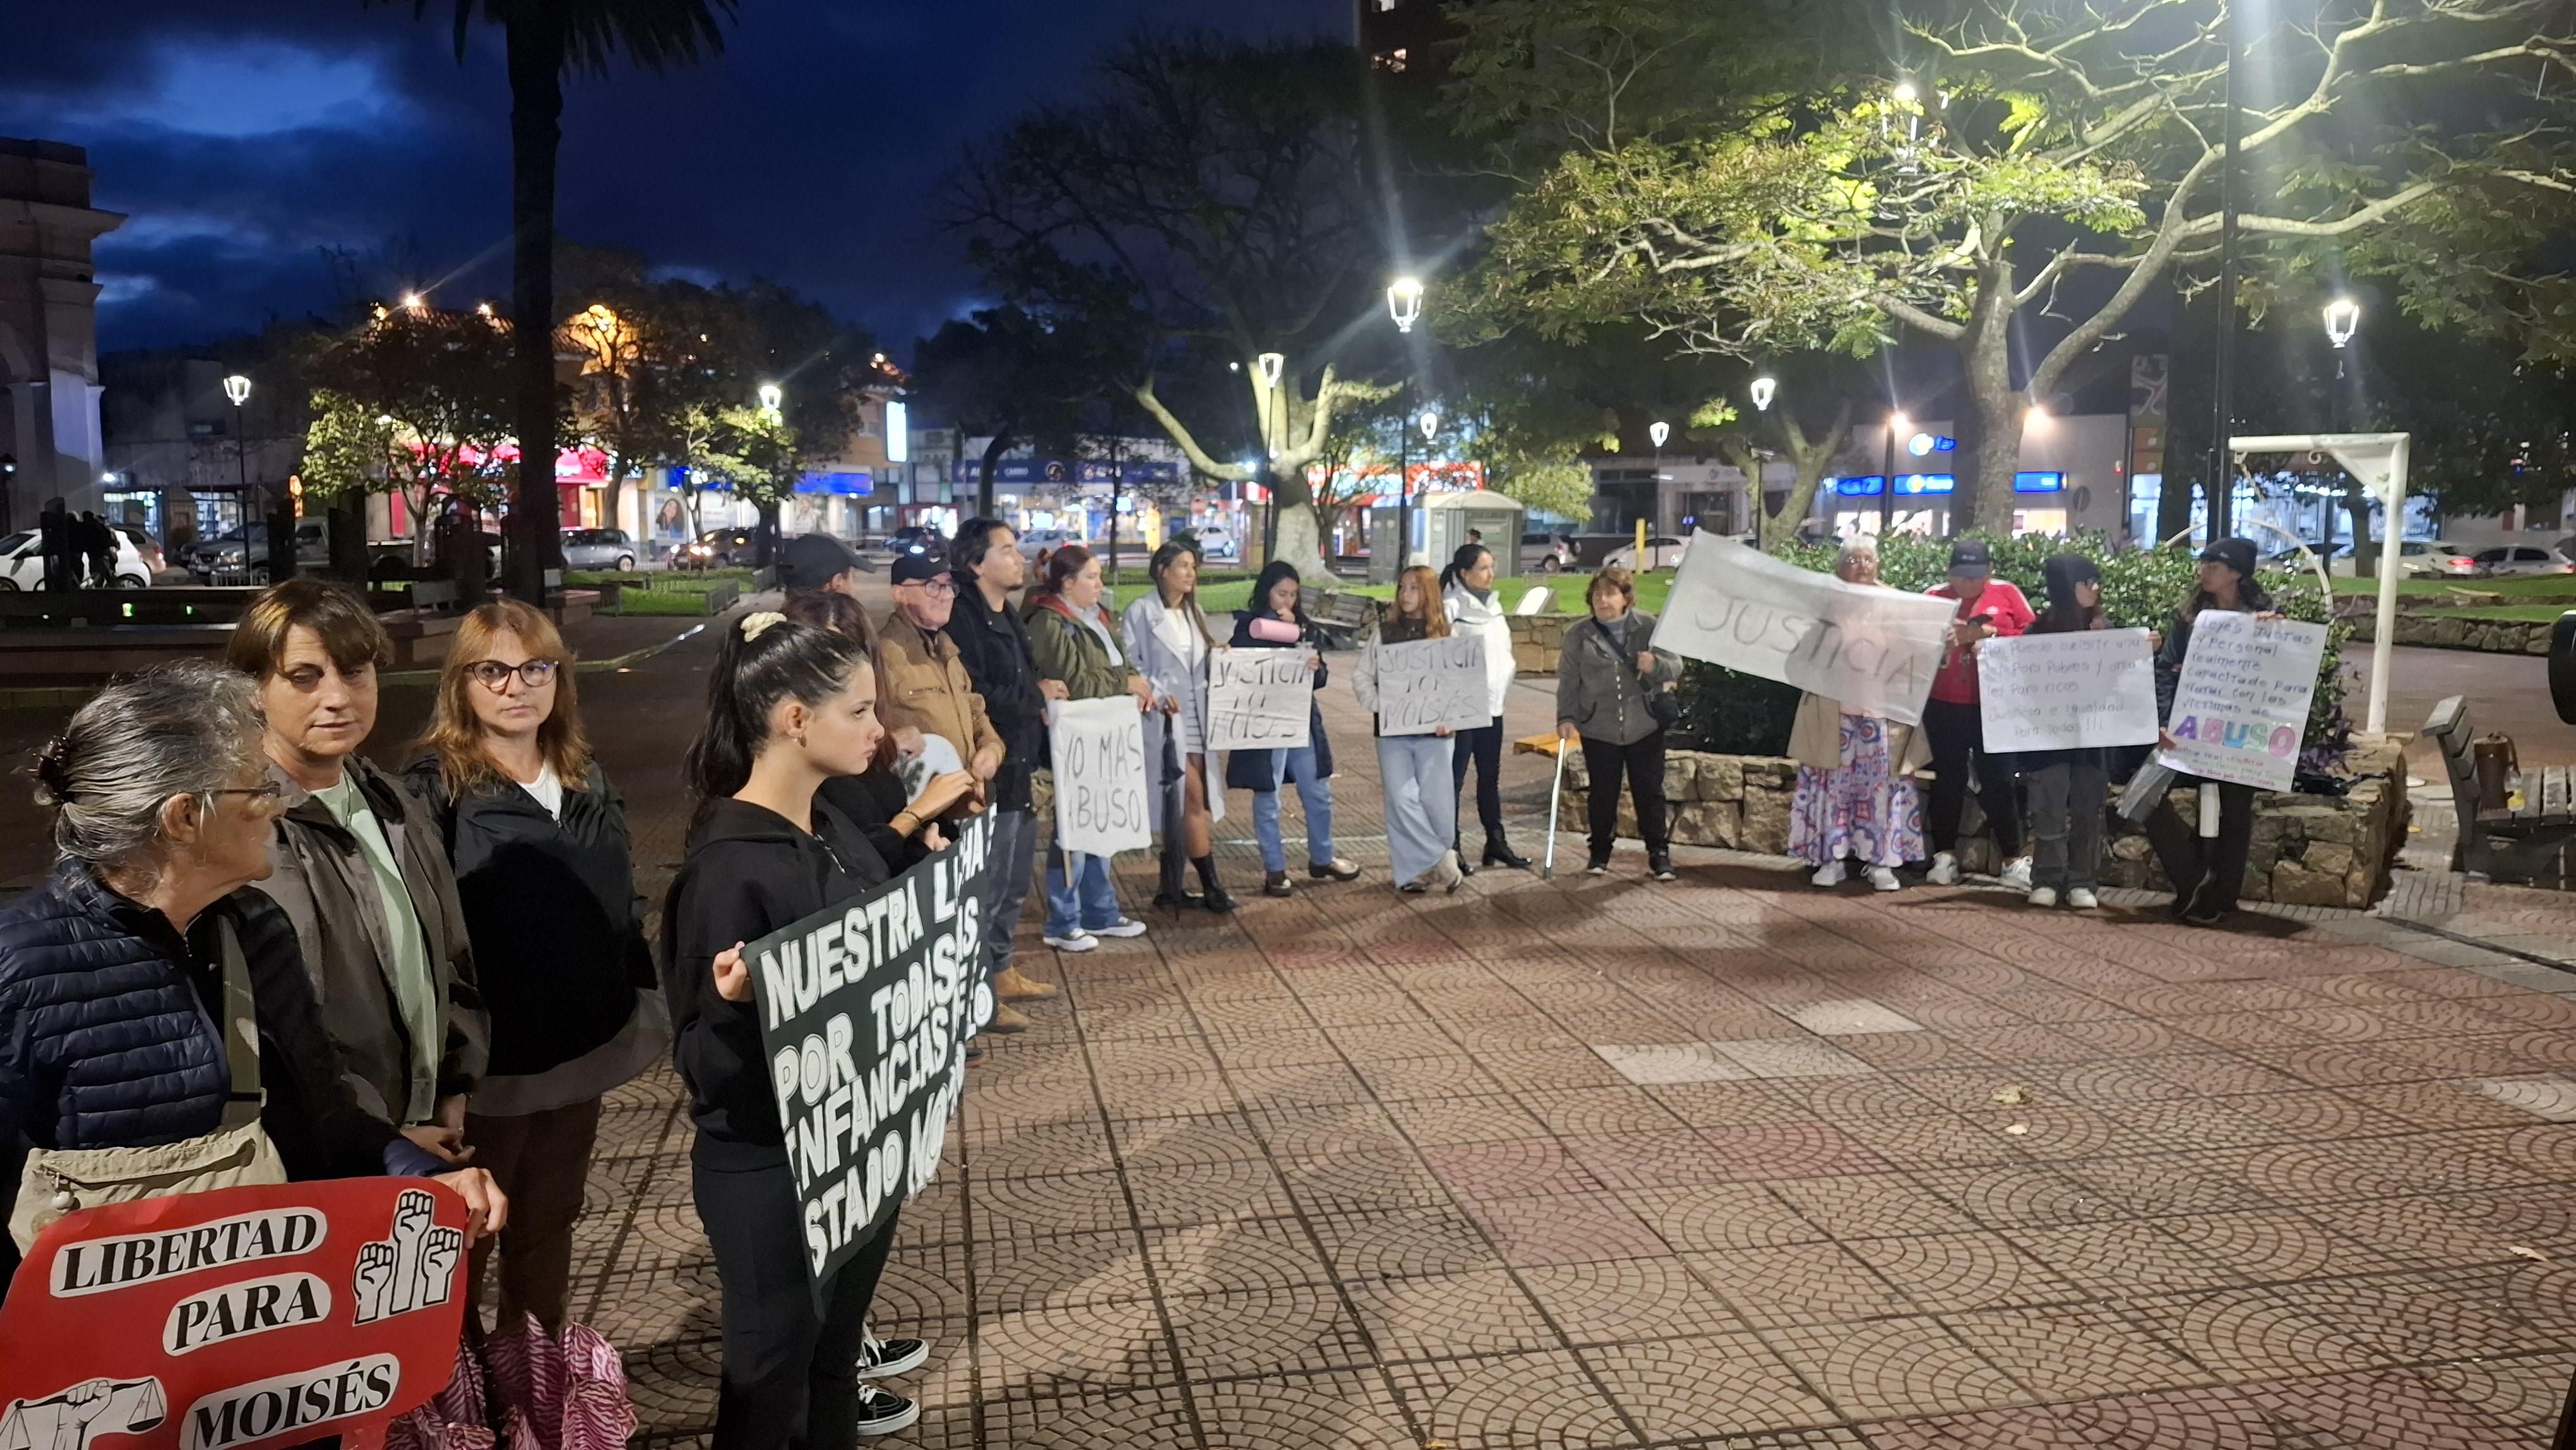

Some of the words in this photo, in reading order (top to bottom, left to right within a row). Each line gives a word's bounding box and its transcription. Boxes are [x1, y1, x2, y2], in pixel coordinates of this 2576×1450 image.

[1695, 596, 1914, 695] JUSTICIA
[1099, 724, 1142, 784] MAS
[2173, 716, 2296, 757] ABUSO
[760, 877, 924, 1031] NUESTRA
[774, 1012, 857, 1132] POR
[871, 932, 958, 1055] TODAS
[796, 1129, 904, 1278] STADO
[60, 1214, 317, 1291] LIBERTAD
[173, 1278, 320, 1351] PARA
[193, 1361, 391, 1447] MOISÉS
